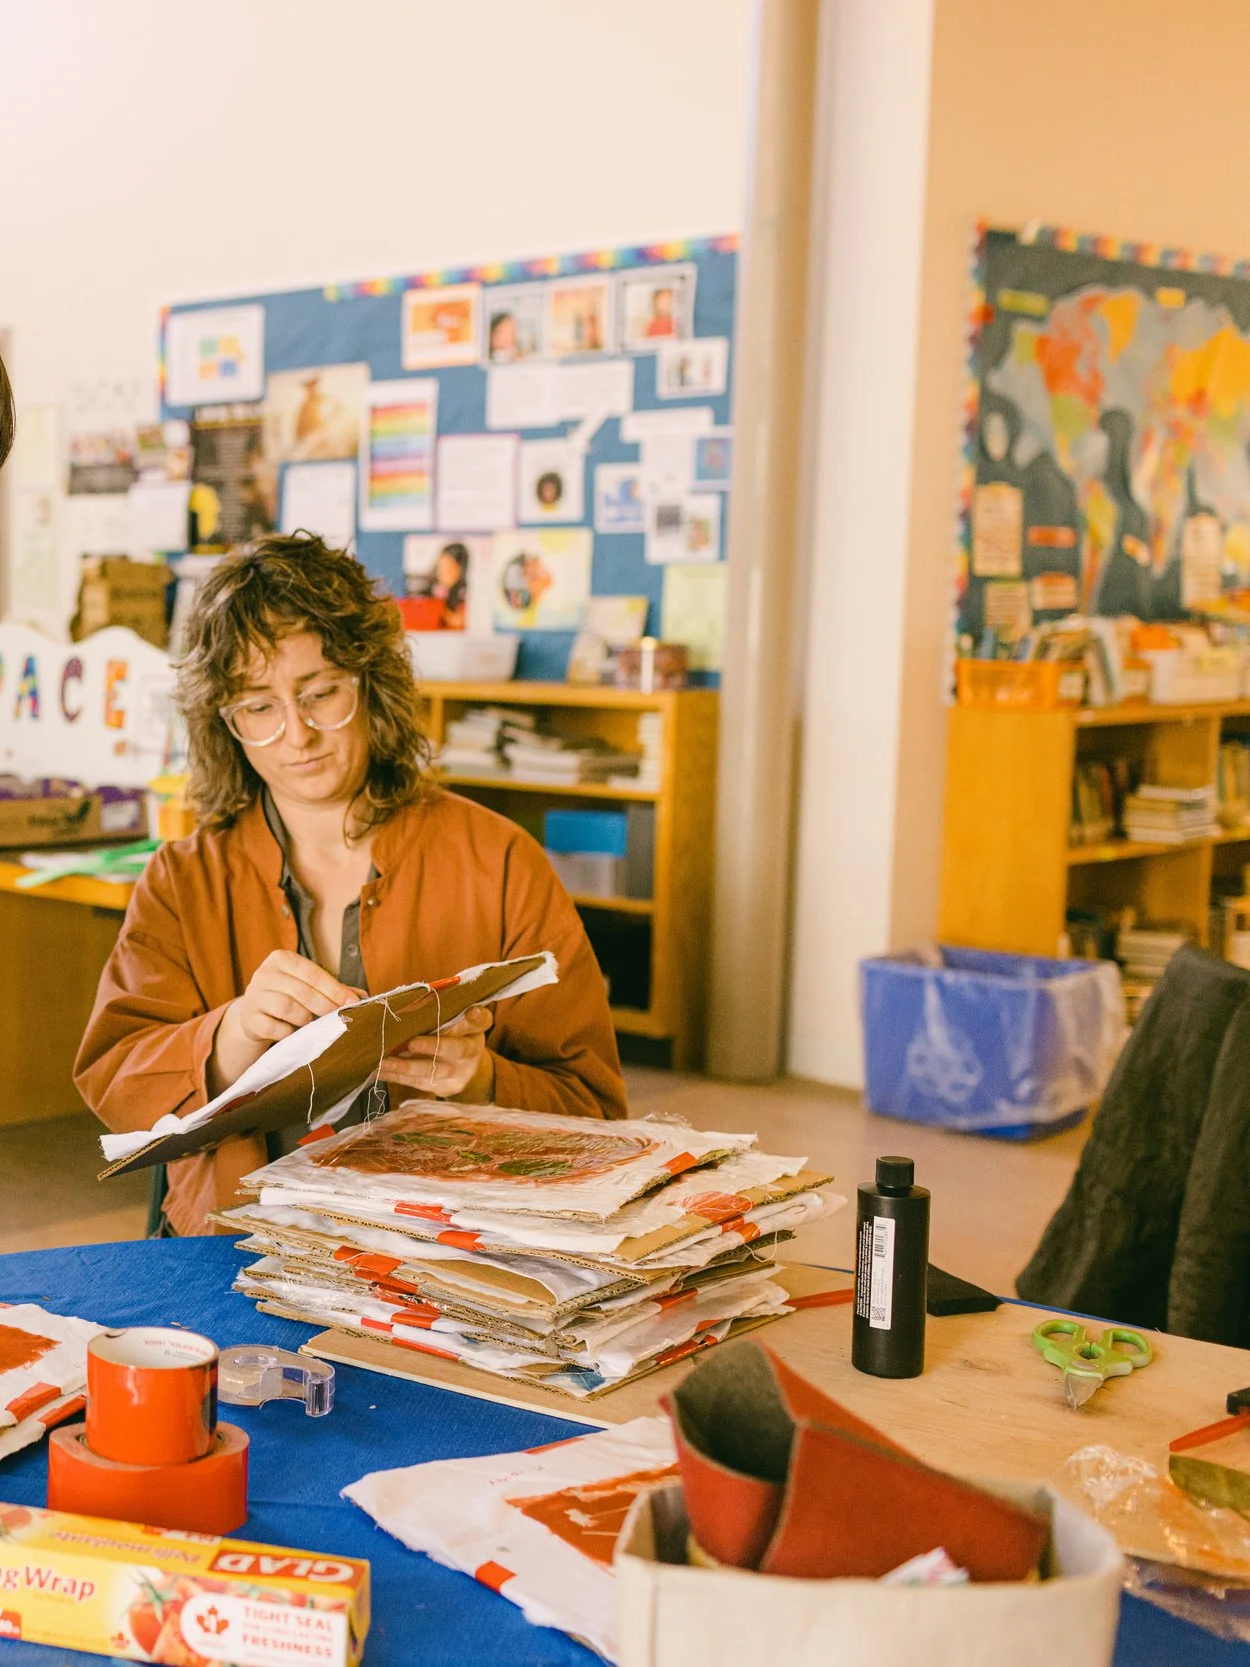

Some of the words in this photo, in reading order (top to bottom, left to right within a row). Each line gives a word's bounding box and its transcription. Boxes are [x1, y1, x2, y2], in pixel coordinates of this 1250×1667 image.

[217, 1553, 354, 1584] GLAD
[243, 1606, 290, 1625] TIGHT
[295, 1615, 332, 1632] SEAL
[242, 1634, 333, 1657] FRESHNESS
